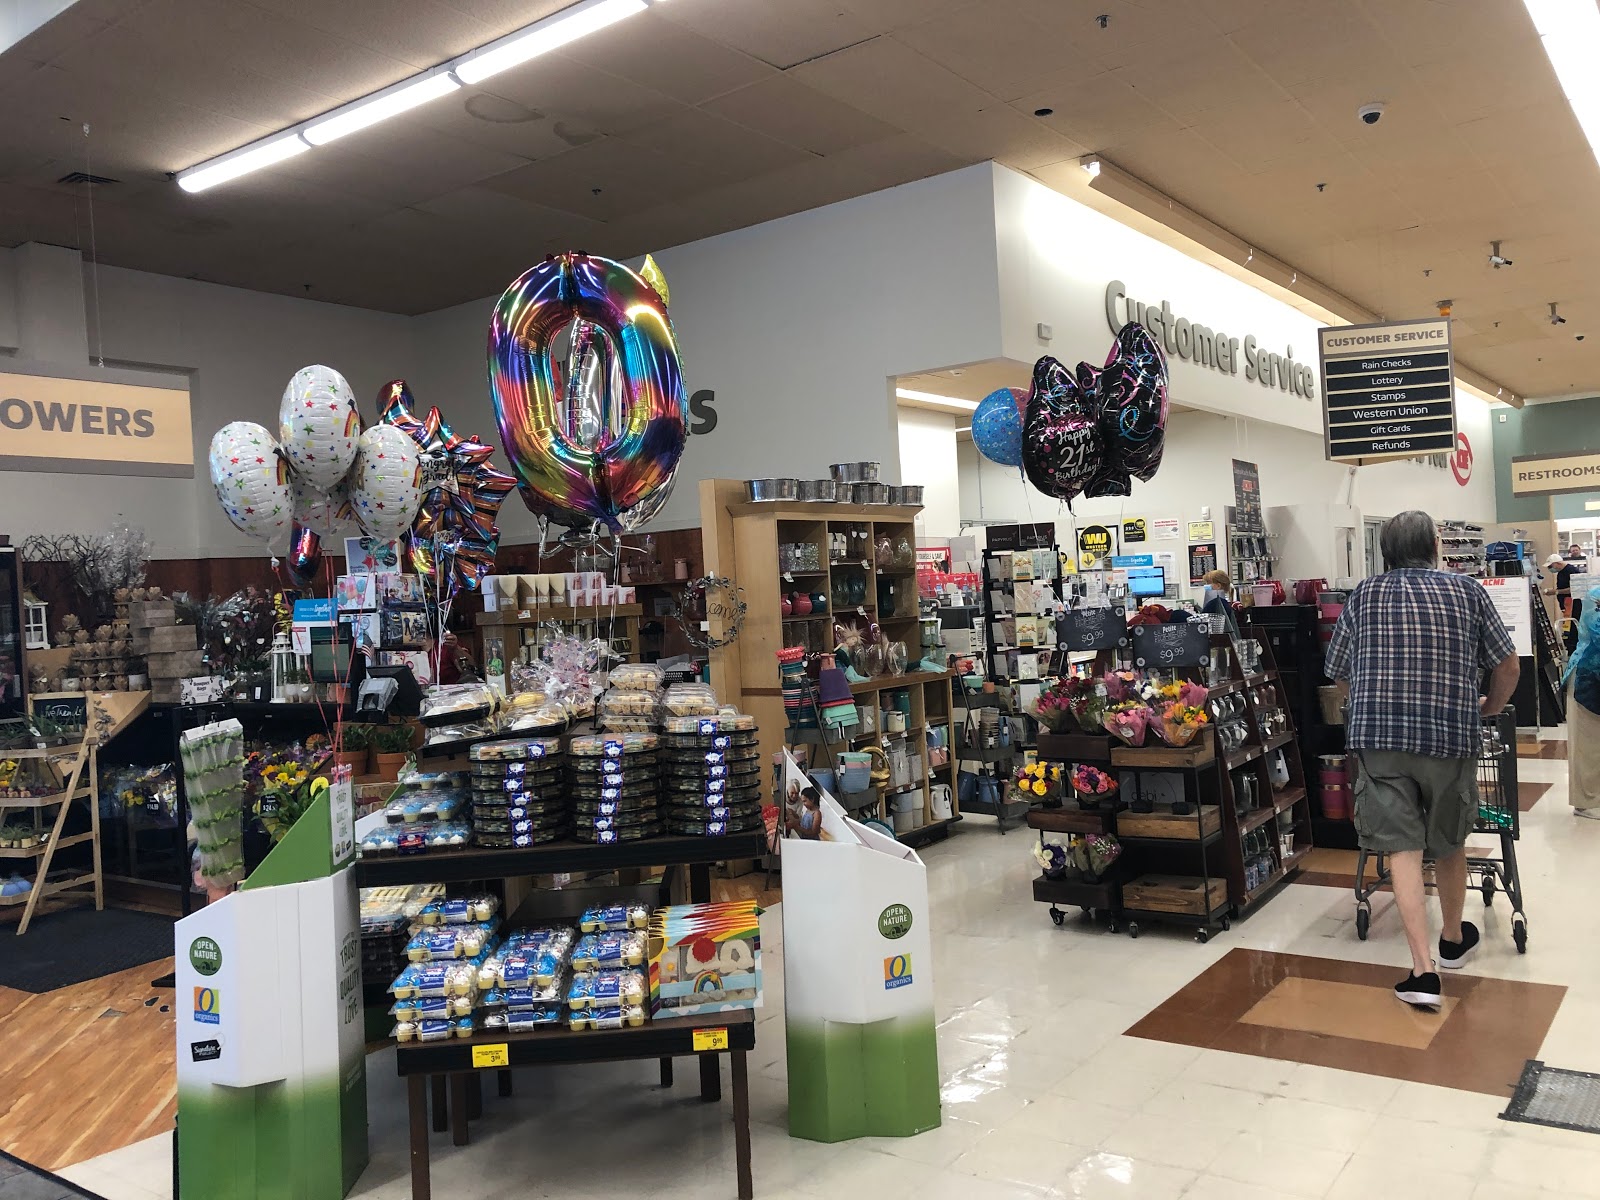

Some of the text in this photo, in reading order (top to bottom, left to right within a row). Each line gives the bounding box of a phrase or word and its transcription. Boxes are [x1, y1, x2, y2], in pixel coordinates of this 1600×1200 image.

[1105, 280, 1315, 399] Customer Service
[1326, 329, 1444, 348] CUSTOMER SERVICE
[1361, 357, 1412, 370] Rain Checks
[1371, 375, 1404, 387] Lottery
[1371, 390, 1406, 403] Stamps
[0, 397, 155, 438] OWERS
[1352, 405, 1429, 419] Western Union
[1370, 423, 1411, 435] Gift Cards
[1056, 428, 1091, 446] Happy
[1372, 440, 1411, 451] Refunds
[1059, 440, 1096, 469] 21st
[1054, 457, 1101, 481] Birthday!
[1518, 465, 1600, 482] RESTROOMS
[1482, 578, 1506, 586] ACME
[1162, 624, 1177, 633] Petite
[886, 907, 903, 918] OPEN
[882, 914, 908, 926] NATURE
[196, 940, 215, 951] OPEN
[193, 949, 218, 961] NATURE
[340, 940, 358, 967] TRUST
[339, 969, 360, 1000] QUALITY
[886, 976, 911, 988] organics
[344, 997, 359, 1024] LOVE
[194, 1012, 220, 1023] organics
